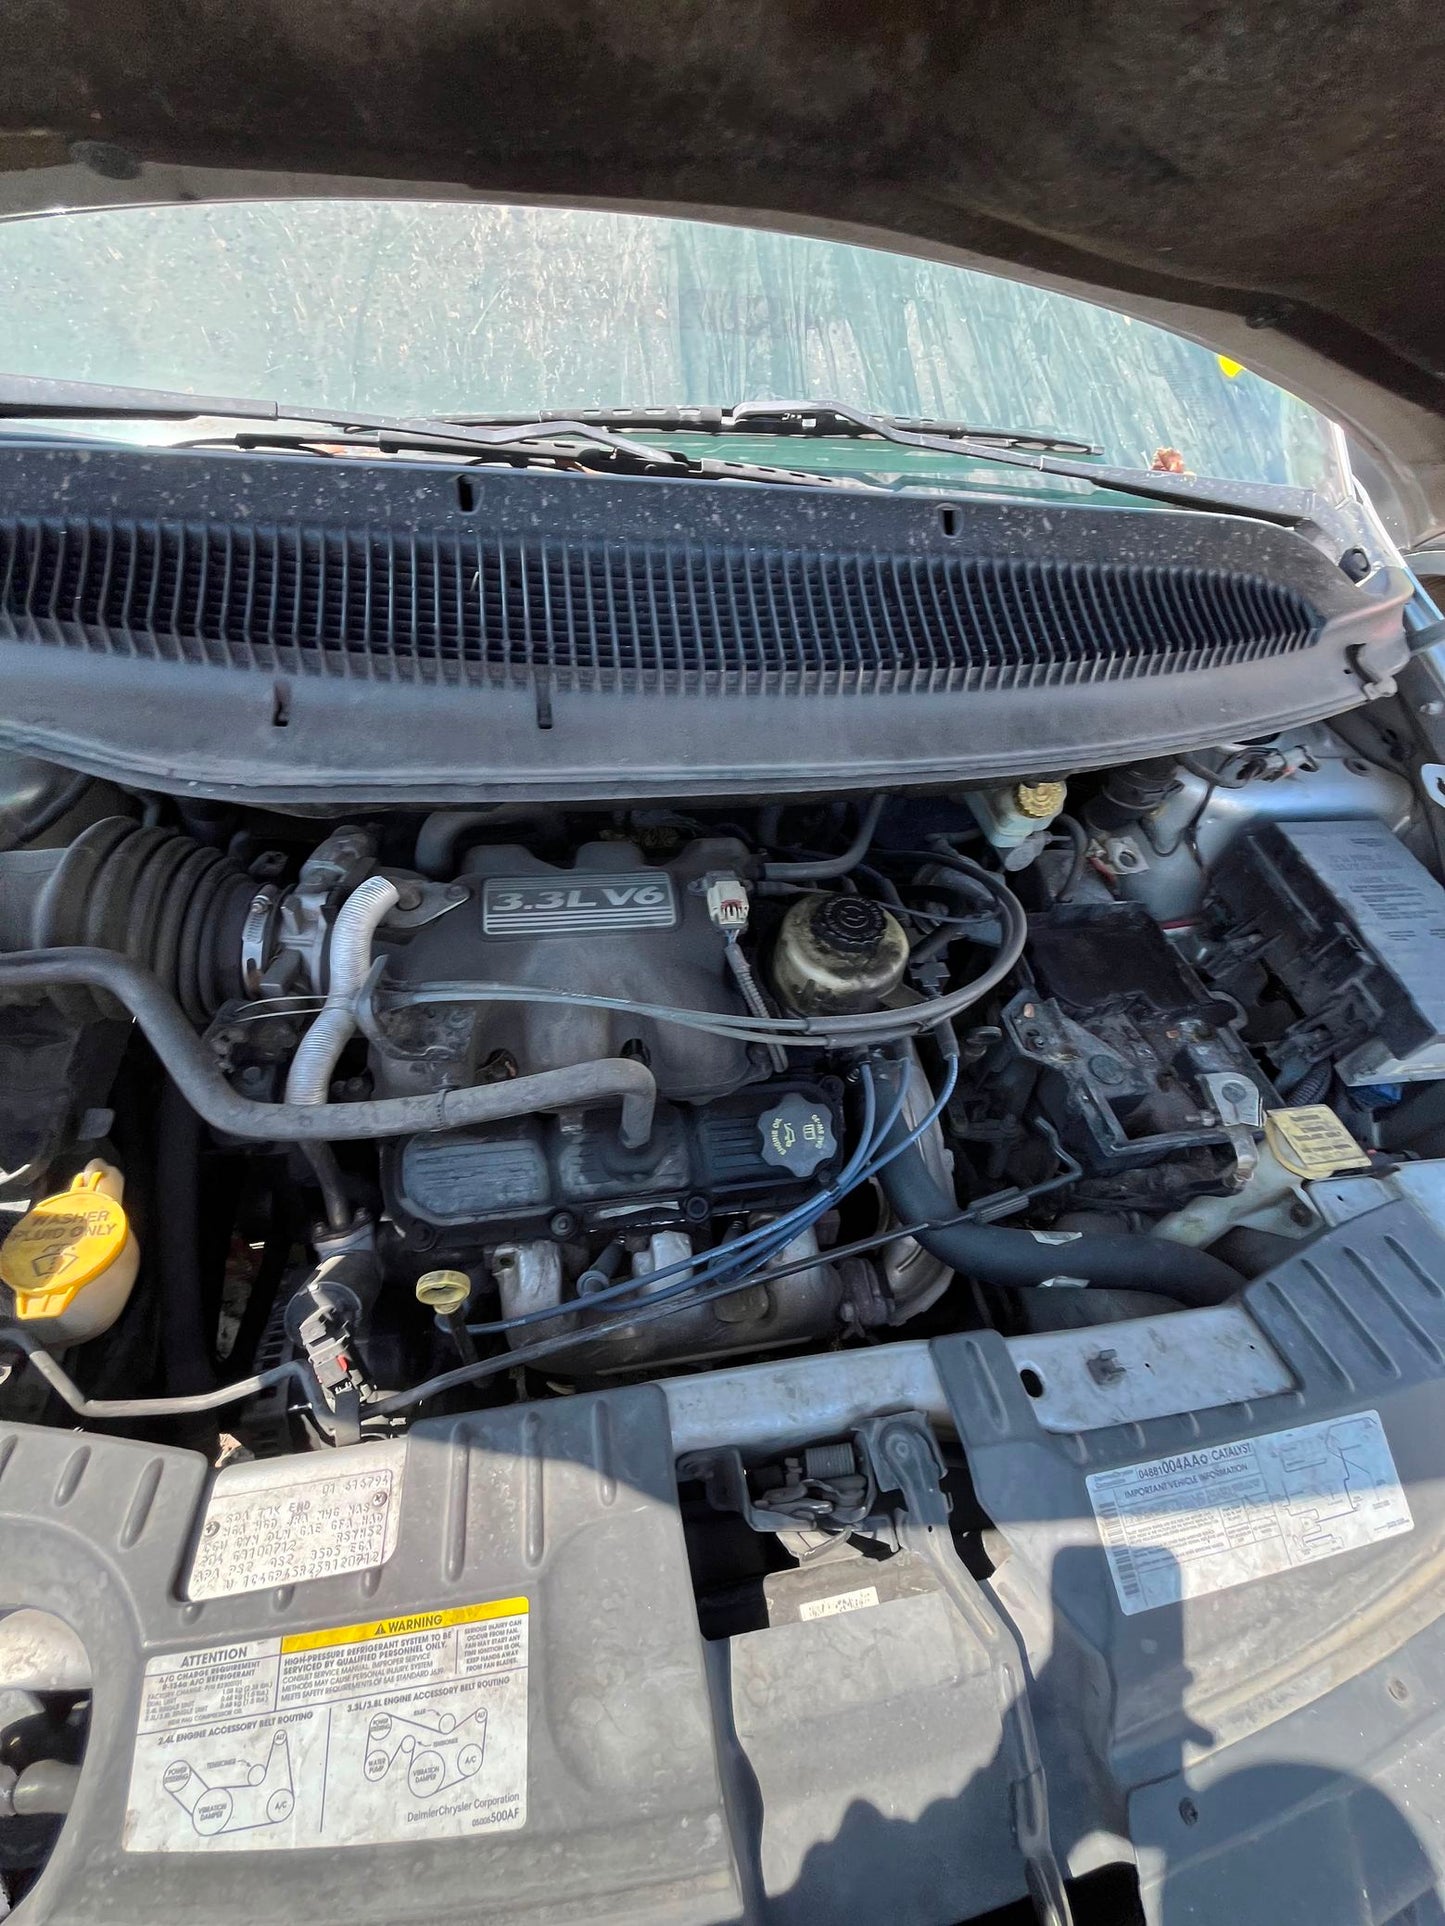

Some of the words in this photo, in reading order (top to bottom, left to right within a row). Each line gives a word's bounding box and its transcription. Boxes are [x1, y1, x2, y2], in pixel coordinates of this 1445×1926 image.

[492, 890, 597, 911] 3.3L
[602, 886, 665, 906] V6
[771, 1130, 787, 1155] ENGINE
[31, 1210, 110, 1226] WASHER
[70, 1223, 118, 1238] ONLY
[1138, 1455, 1200, 1479] 04881004AA
[1211, 1443, 1251, 1461] CATALYST
[1124, 1482, 1168, 1499] IMPORTANT
[1168, 1475, 1198, 1489] VEHICLE
[1200, 1463, 1249, 1484] INFORMATION
[388, 1613, 443, 1633] WARNING
[488, 1621, 507, 1630] INJURY
[466, 1632, 487, 1641] OCCUR
[489, 1629, 505, 1637] FROM
[491, 1636, 507, 1644] START
[284, 1648, 345, 1666] HIGH-PRESSURE
[346, 1639, 398, 1656] REFRIGERANT
[400, 1634, 429, 1647] SYSTEM
[431, 1632, 441, 1641] TO
[442, 1630, 451, 1639] BE
[477, 1645, 503, 1654] IGNITION
[180, 1646, 247, 1668] ATTENTION
[283, 1661, 325, 1675] SERVICED
[324, 1659, 334, 1668] BY
[336, 1652, 376, 1666] QUALIFIED
[378, 1644, 423, 1659] PERSONNEL
[466, 1656, 479, 1664] KEEP
[480, 1653, 500, 1661] HANDS
[501, 1650, 518, 1658] AWAY
[176, 1669, 208, 1680] CHARGE
[210, 1660, 260, 1674] REQUIREMENT
[282, 1672, 312, 1684] CONSULT
[313, 1667, 340, 1678] SERVICE
[371, 1656, 403, 1669] IMPROPER
[405, 1652, 430, 1663] SERVICE
[466, 1663, 482, 1672] FROM
[483, 1661, 494, 1669] FAN
[206, 1669, 255, 1682] REFRIGERANT
[282, 1681, 312, 1692] METHODS
[314, 1678, 328, 1687] MAY
[329, 1674, 351, 1684] CAUSE
[352, 1668, 384, 1680] PERSONAL
[410, 1660, 433, 1670] SYSTEM
[281, 1692, 301, 1701] MEETS
[302, 1687, 324, 1698] SAFETY
[325, 1679, 373, 1694] REQUIREMENTS
[373, 1678, 382, 1686] OF
[396, 1670, 428, 1681] STANDARD
[346, 1698, 382, 1713] 3.3L/3.8L
[383, 1693, 411, 1705] ENGINE
[412, 1685, 457, 1701] ACCESSORY
[460, 1682, 475, 1692] BELT
[477, 1675, 509, 1689] ROUTING
[157, 1735, 175, 1745] 2.4L
[176, 1729, 206, 1742] ENGINE
[207, 1721, 257, 1736] ACCESSORY
[258, 1717, 276, 1728] BELT
[278, 1710, 314, 1725] ROUTING
[368, 1757, 386, 1766] WATER
[464, 1754, 476, 1764] A/C
[167, 1766, 187, 1775] POWER
[369, 1765, 384, 1774] PUMP
[412, 1765, 439, 1776] VIBRATION
[415, 1774, 436, 1783] DAMPER
[198, 1803, 227, 1814] VIBRATION
[274, 1801, 287, 1810] A/C
[407, 1800, 472, 1822] DaimlerChrysler
[473, 1791, 519, 1809] Corporation
[200, 1812, 223, 1821] DAMPER
